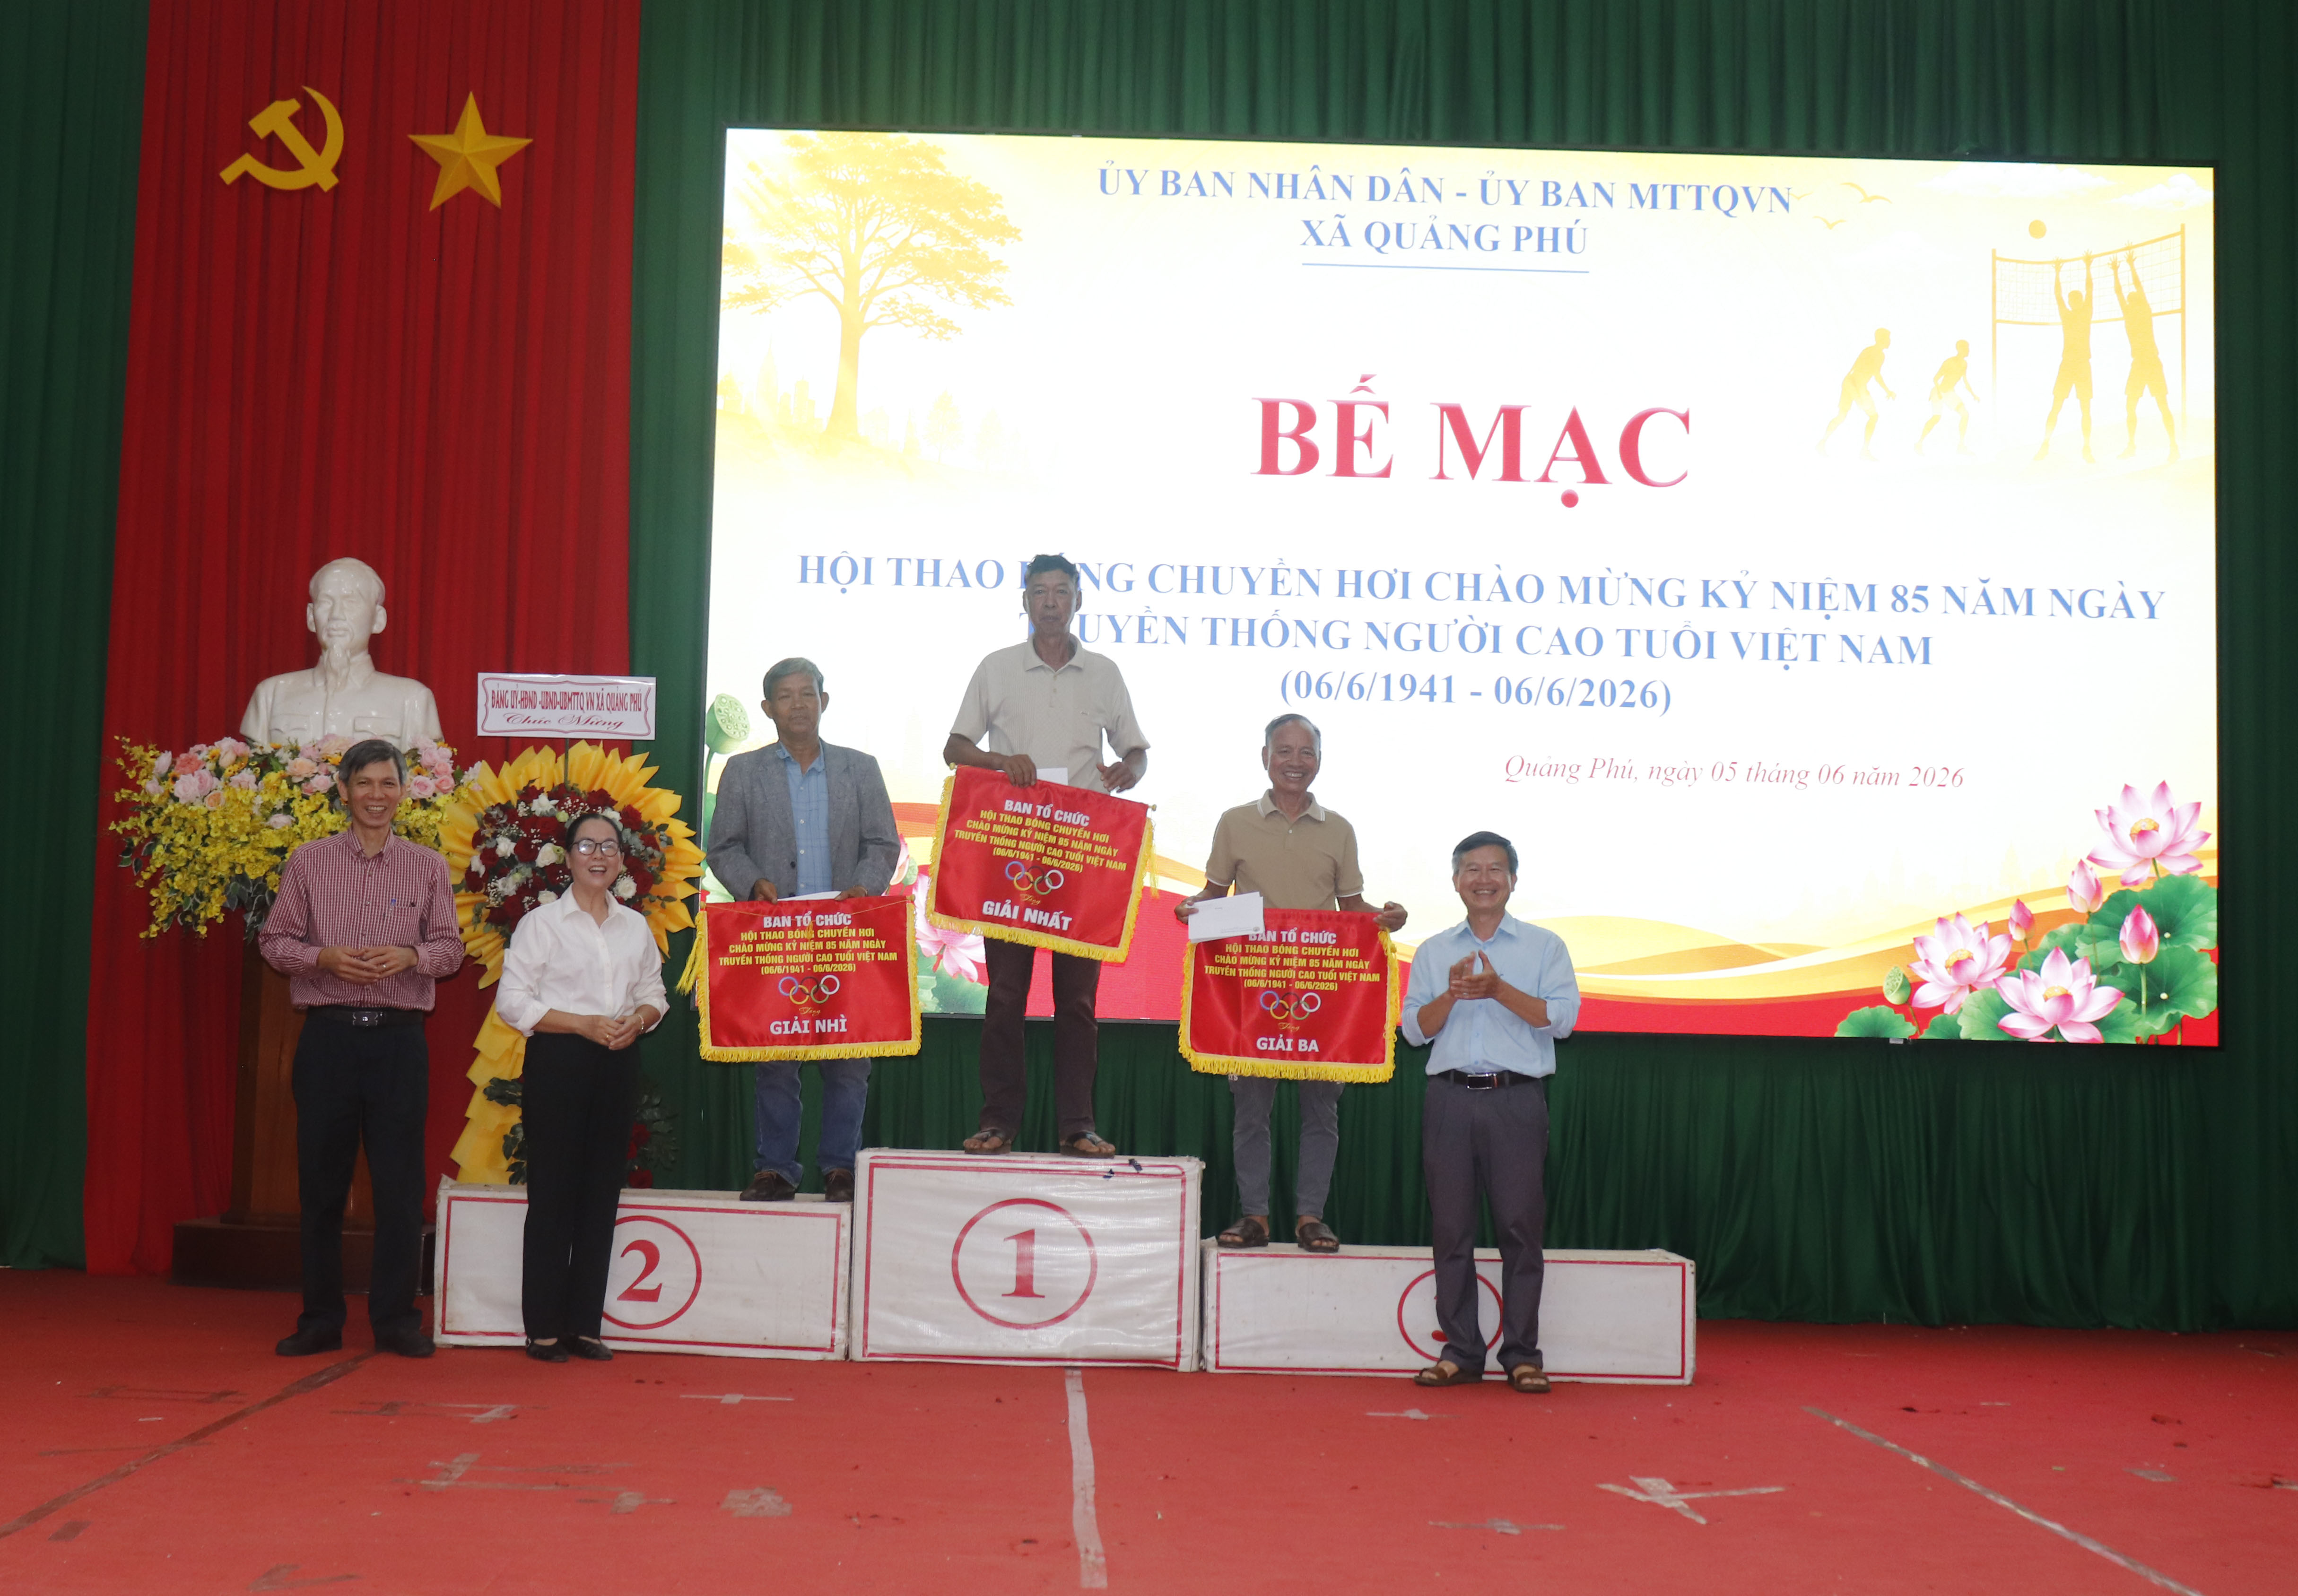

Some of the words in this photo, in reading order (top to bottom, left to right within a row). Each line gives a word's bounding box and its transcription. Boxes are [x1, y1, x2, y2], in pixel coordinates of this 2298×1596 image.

[1101, 161, 1148, 195] ỦY
[1162, 170, 1233, 197] BAN
[1249, 165, 1352, 200] NHÂN
[1369, 167, 1443, 203] DÂN
[1481, 172, 1528, 206] ỦY
[1542, 182, 1615, 208] BAN
[1630, 183, 1791, 218] MTTQVN
[1302, 214, 1352, 247] XÃ
[1364, 216, 1500, 254] QUẢNG
[1515, 219, 1587, 254] PHÚ
[1251, 374, 1393, 478] BẾ
[1430, 403, 1689, 508] MẠC
[799, 551, 873, 594] HỘI
[888, 558, 1004, 589] THAO
[1017, 553, 1135, 592] NG
[1149, 558, 1321, 597] CHUYỀN
[1337, 568, 1410, 599] HƠI
[1426, 564, 1544, 604] CHÀO
[1558, 567, 1686, 607] MỪNG
[1702, 571, 1758, 608] KỶ
[1773, 581, 1876, 620] NIỆM
[1891, 585, 1929, 613] 85
[1943, 579, 2035, 616] NĂM
[2050, 581, 2165, 619] NGÀY
[1019, 606, 1188, 645] UYỀN
[1202, 610, 1350, 650] THỐNG
[1366, 615, 1502, 653] NGƯỜI
[1516, 625, 1604, 657] CAO
[1616, 621, 1716, 659] TUỔI
[1731, 628, 1827, 671] VIỆT
[1840, 634, 1931, 665] NAM
[1281, 670, 1453, 705] (06/6/1941
[1495, 677, 1671, 715] 06/6/2026)
[1506, 756, 1581, 783] Quảng
[1589, 758, 1637, 783] Phú,
[1649, 761, 1702, 787] ngày
[1712, 762, 1738, 781] 05
[1747, 762, 1810, 788] tháng
[1819, 765, 1844, 783] 06
[1854, 768, 1899, 785] năm
[1909, 766, 1963, 787] 2026
[980, 810, 996, 822] HỘI
[999, 813, 1023, 825] THAO
[1025, 816, 1051, 831] BÓNG
[1053, 823, 1090, 839] CHUYỀN
[1093, 832, 1109, 843] HƠI
[1004, 799, 1032, 815] BAN
[1036, 804, 1053, 818] TỔ
[1054, 809, 1090, 826] CHỨC
[955, 829, 987, 843] TRUYỀN
[990, 835, 1017, 848] THỐNG
[1018, 840, 1045, 853] NGƯỜI
[1047, 847, 1063, 857] CAO
[1065, 849, 1084, 861] TUỔI
[1087, 855, 1104, 867] VIỆT
[1107, 860, 1127, 871] NAM
[967, 819, 991, 832] CHÀO
[993, 824, 1019, 837] MỪNG
[1021, 827, 1033, 839] KỶ
[1035, 832, 1056, 845] NIỆM
[1058, 837, 1069, 846] 85
[1071, 839, 1092, 850] NĂM
[1094, 844, 1118, 856] NGÀY
[764, 916, 792, 928] BAN
[816, 912, 851, 926] CHỨC
[982, 899, 1019, 919] GIẢI
[1024, 907, 1072, 931] NHẤT
[729, 943, 753, 953] CHÀO
[756, 942, 783, 952] MỪNG
[785, 940, 797, 951] KỶ
[800, 940, 823, 952] NIỆM
[826, 941, 836, 949] 85
[839, 939, 860, 949] NĂM
[863, 939, 886, 948] NGÀY
[741, 931, 757, 942] HỘI
[760, 931, 784, 940] THAO
[818, 926, 856, 938] CHUYỀN
[859, 928, 874, 937] HƠI
[1226, 943, 1242, 954] HỘI
[1245, 945, 1269, 953] THAO
[1272, 944, 1298, 956] BÓNG
[1302, 945, 1340, 956] CHUYỀN
[1342, 948, 1358, 957] HƠI
[1280, 927, 1297, 942] TỔ
[1301, 930, 1336, 944] CHỨC
[719, 954, 752, 965] TRUYỀN
[755, 953, 783, 964] THỐNG
[786, 952, 813, 963] NGƯỜI
[816, 954, 832, 962] CAO
[835, 950, 854, 961] TUỔI
[857, 952, 875, 963] VIỆT
[878, 953, 897, 961] NAM
[1205, 965, 1236, 976] TRUYỀN
[1238, 966, 1267, 977] THỐNG
[1269, 968, 1296, 979] NGƯỜI
[1298, 971, 1315, 979] CAO
[1318, 969, 1337, 980] TUỔI
[1339, 971, 1358, 982] VIỆT
[1360, 973, 1380, 981] NAM
[1215, 954, 1237, 964] CHÀO
[1240, 955, 1266, 965] MỪNG
[1270, 955, 1280, 965] KỶ
[1283, 956, 1306, 968] NIỆM
[1309, 959, 1320, 967] 85
[1323, 958, 1343, 968] NĂM
[1346, 959, 1370, 969] NGÀY
[770, 1016, 810, 1034] GIẢI
[816, 1015, 847, 1032] NHÌ
[1257, 1034, 1293, 1051] GIẢI
[1298, 1039, 1319, 1052] BA
[618, 1240, 662, 1302] 2
[1002, 1229, 1045, 1298] 1
